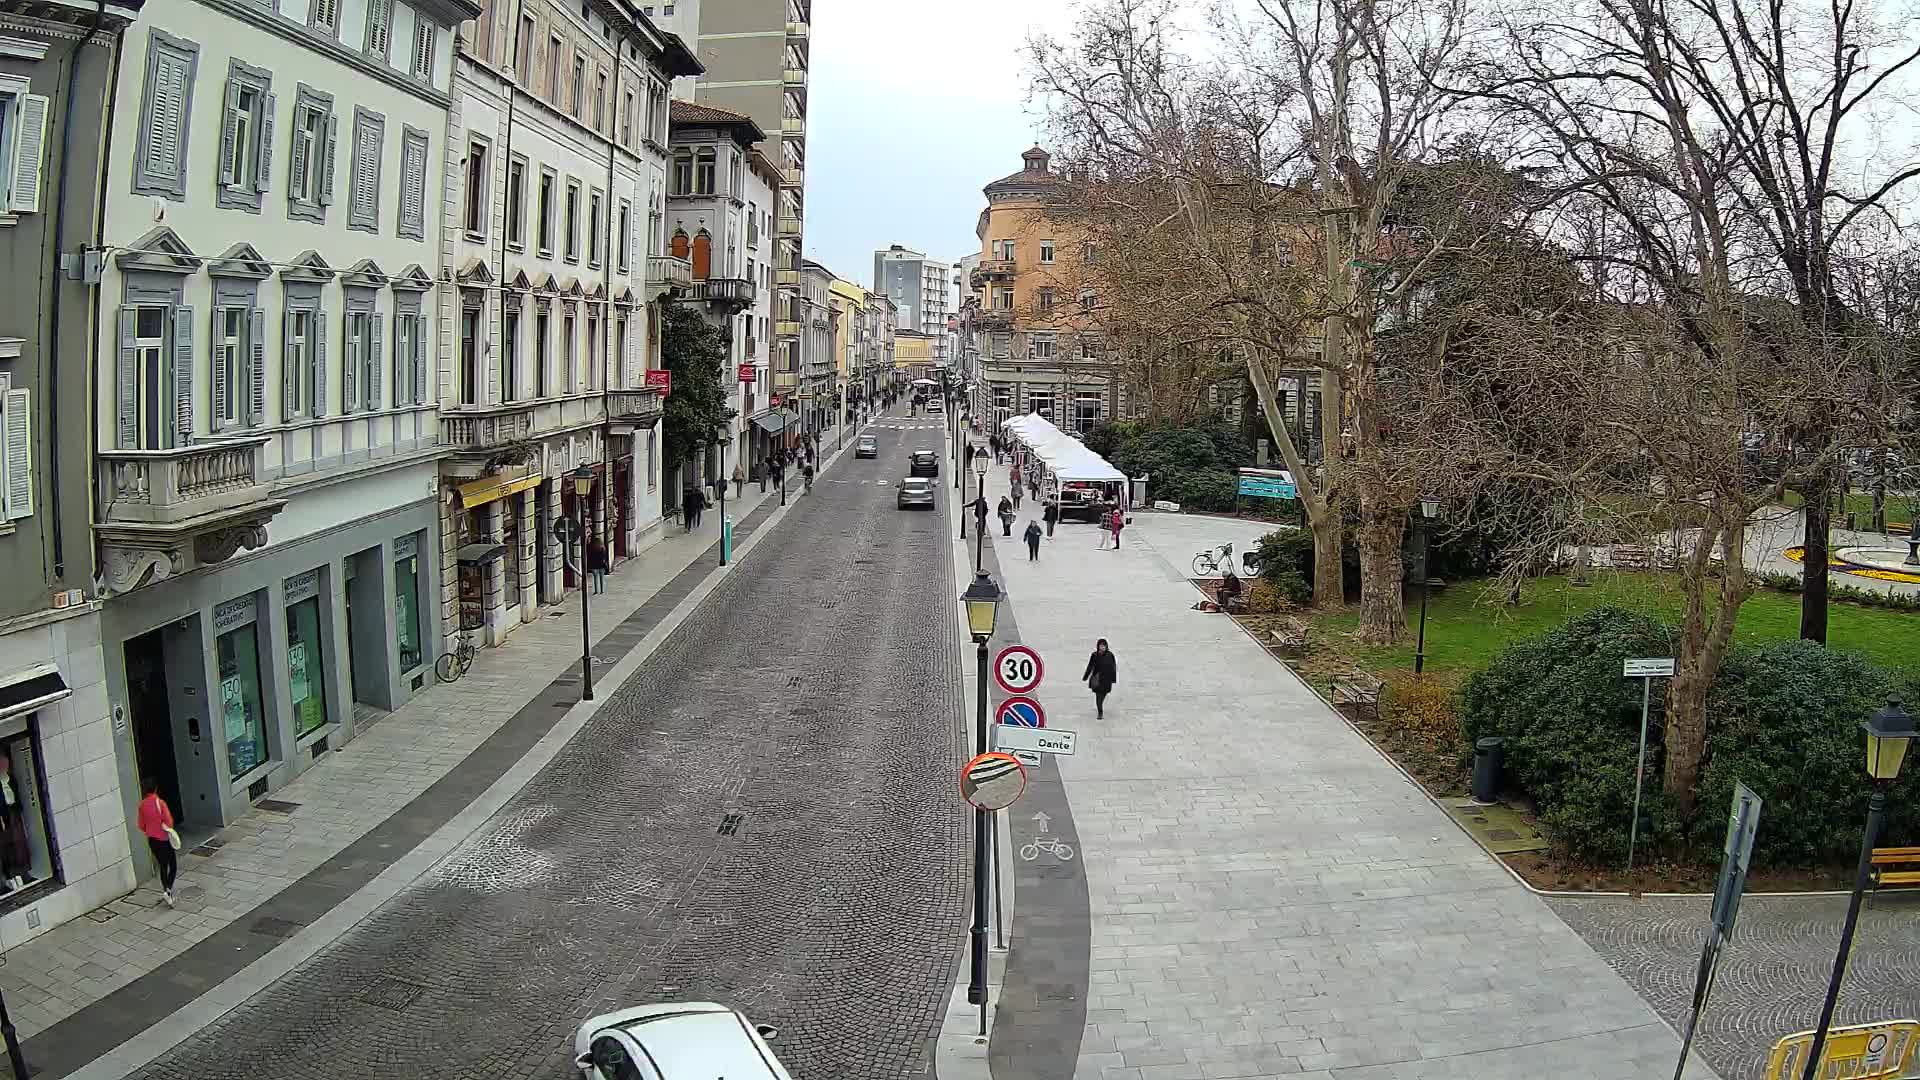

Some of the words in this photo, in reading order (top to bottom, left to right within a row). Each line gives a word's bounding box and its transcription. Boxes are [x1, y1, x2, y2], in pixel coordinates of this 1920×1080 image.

[289, 646, 304, 667] 130
[1005, 658, 1033, 681] 30
[222, 678, 240, 700] 130
[1038, 739, 1070, 750] Dante
